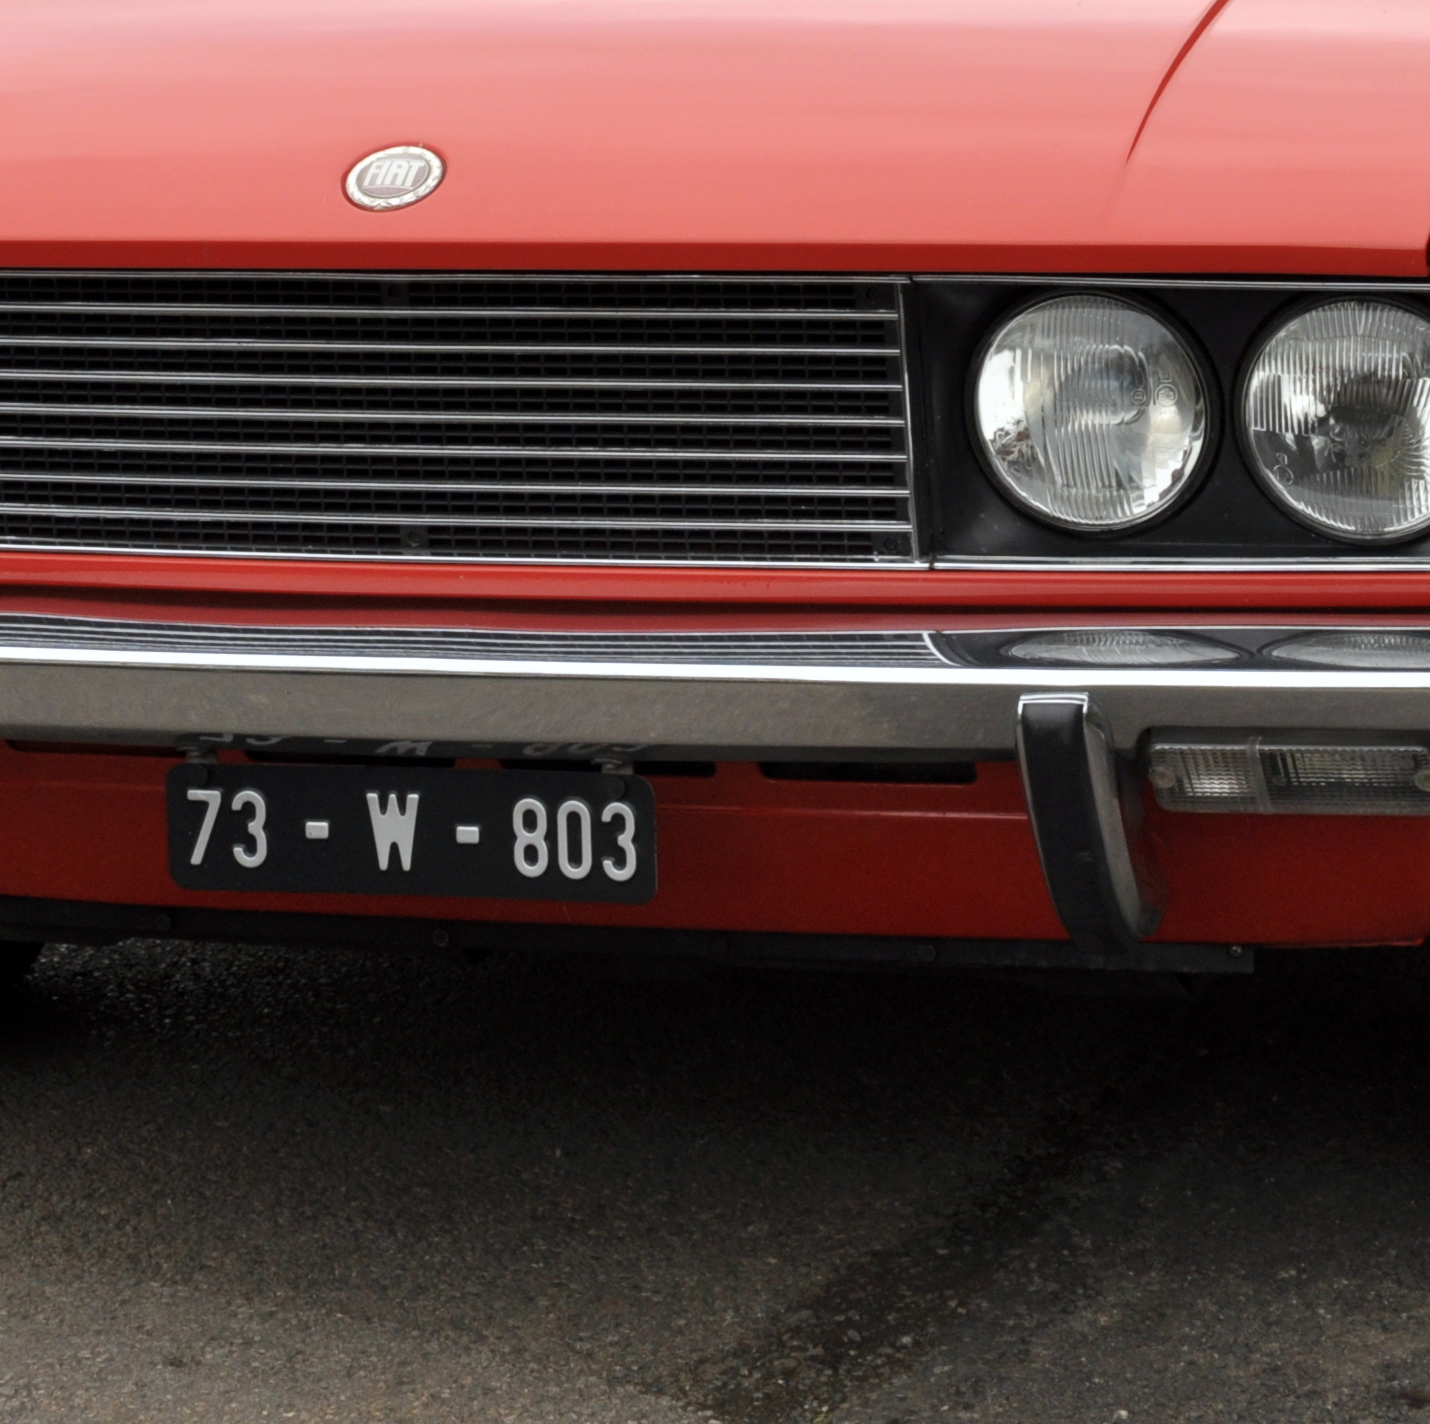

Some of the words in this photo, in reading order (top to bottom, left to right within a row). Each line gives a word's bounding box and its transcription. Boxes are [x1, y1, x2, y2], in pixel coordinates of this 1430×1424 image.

[362, 158, 425, 188] FIAT
[186, 788, 268, 868] 73
[365, 792, 420, 872] W
[512, 797, 638, 882] 803
